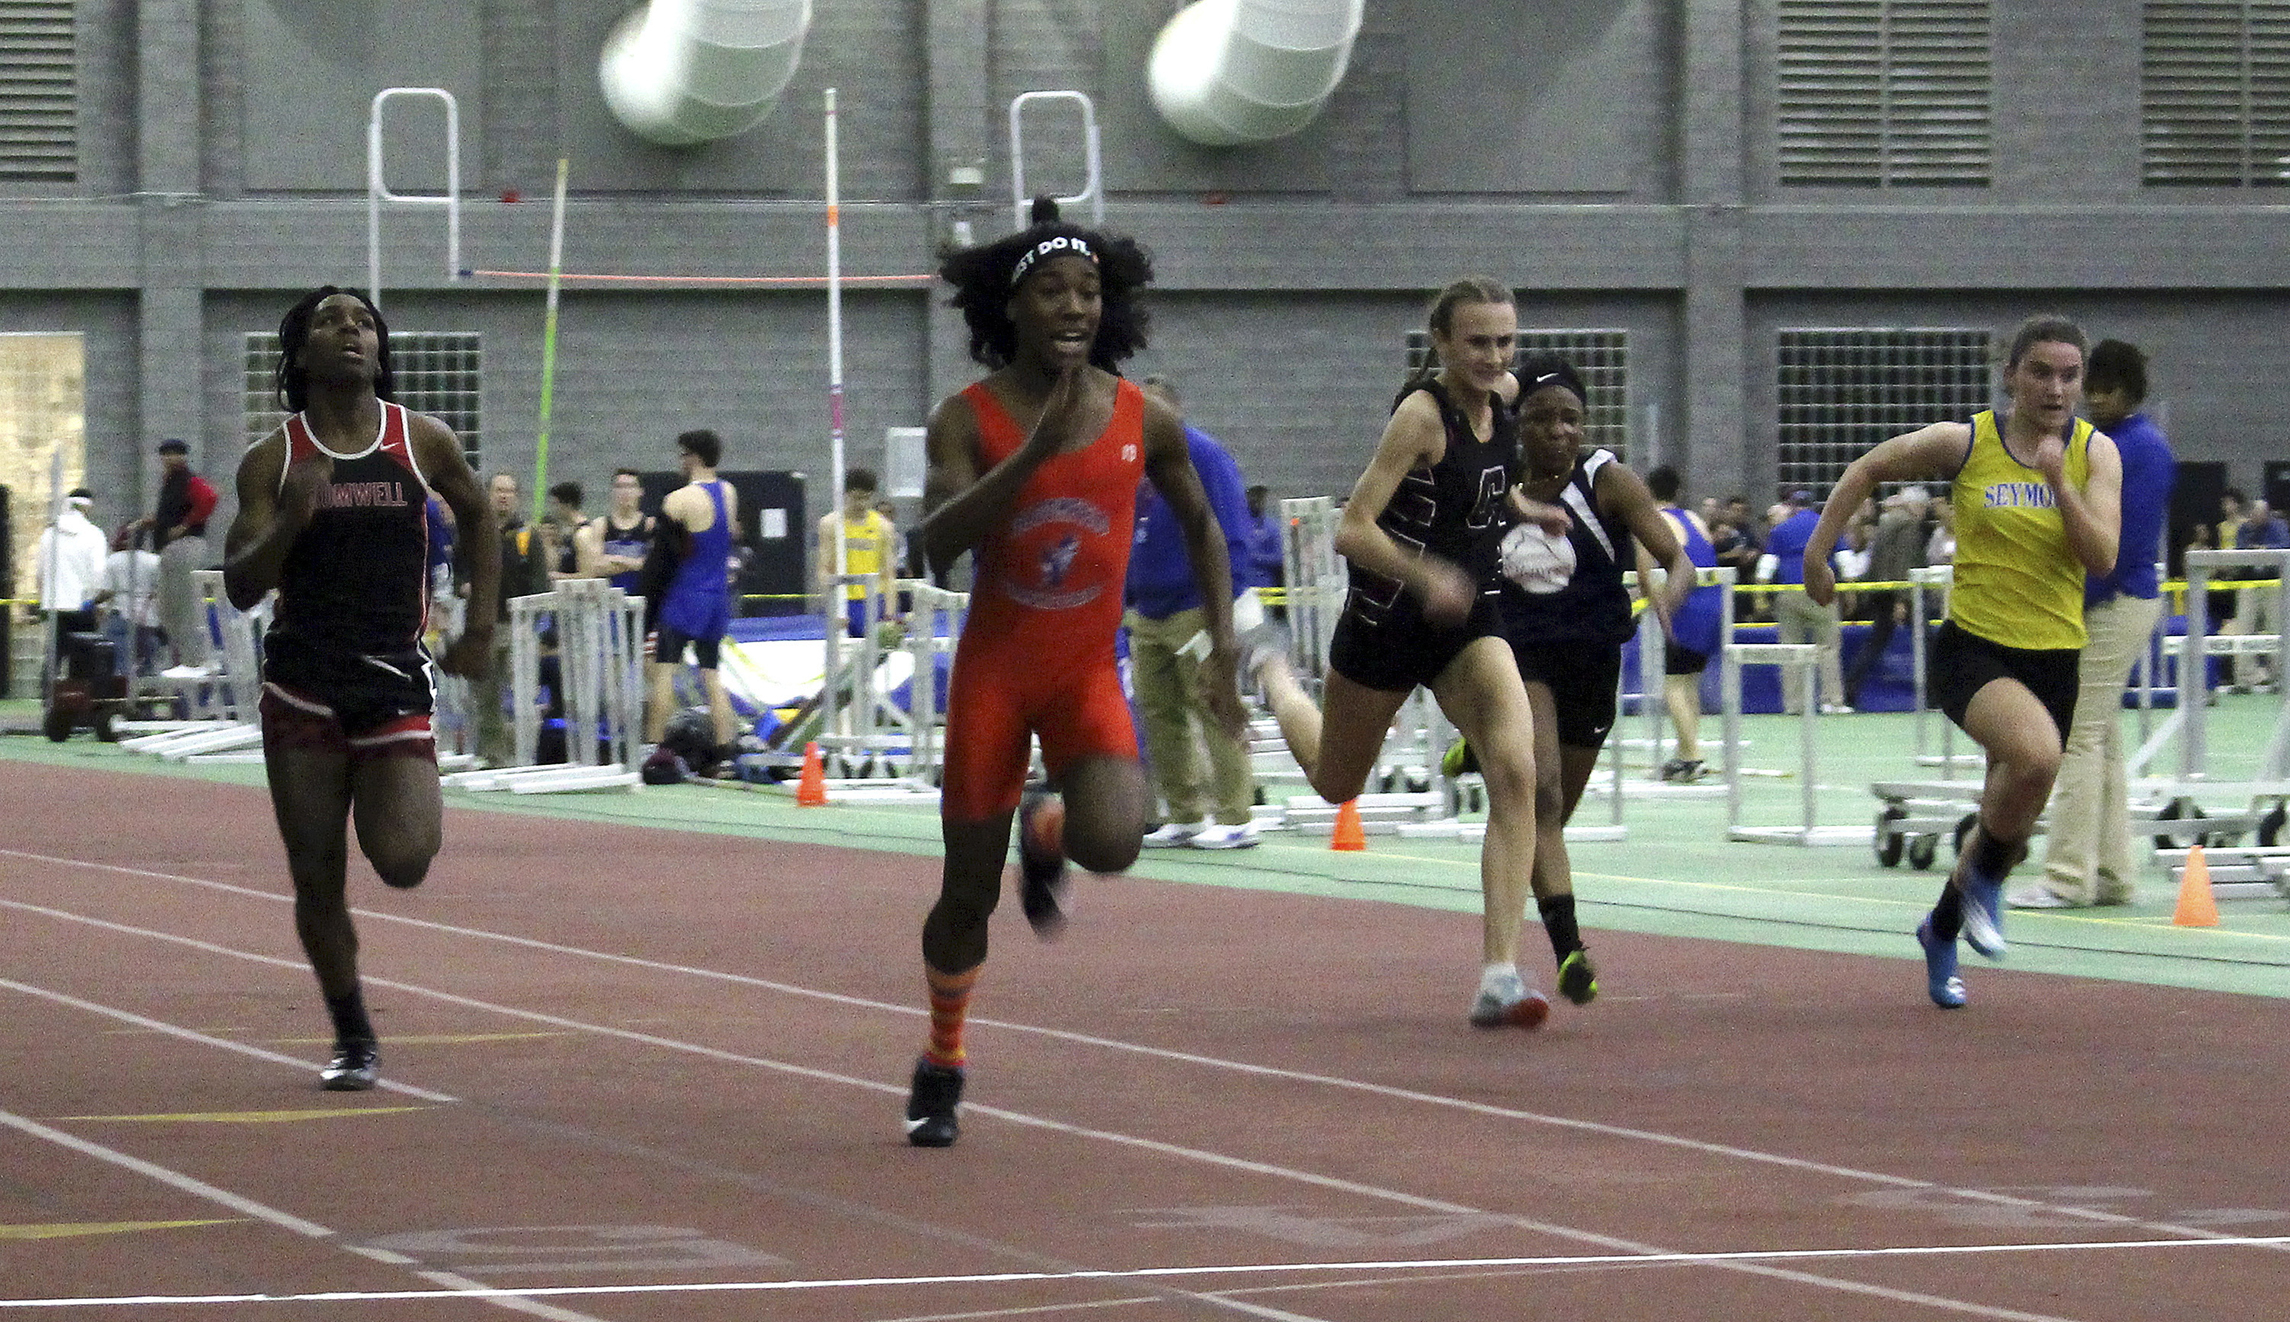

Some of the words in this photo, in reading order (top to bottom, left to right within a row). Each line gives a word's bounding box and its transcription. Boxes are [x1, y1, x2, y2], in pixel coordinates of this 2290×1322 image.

[1037, 236, 1068, 255] DO
[315, 482, 408, 508] OMWELL
[1983, 482, 2057, 508] SEYMO
